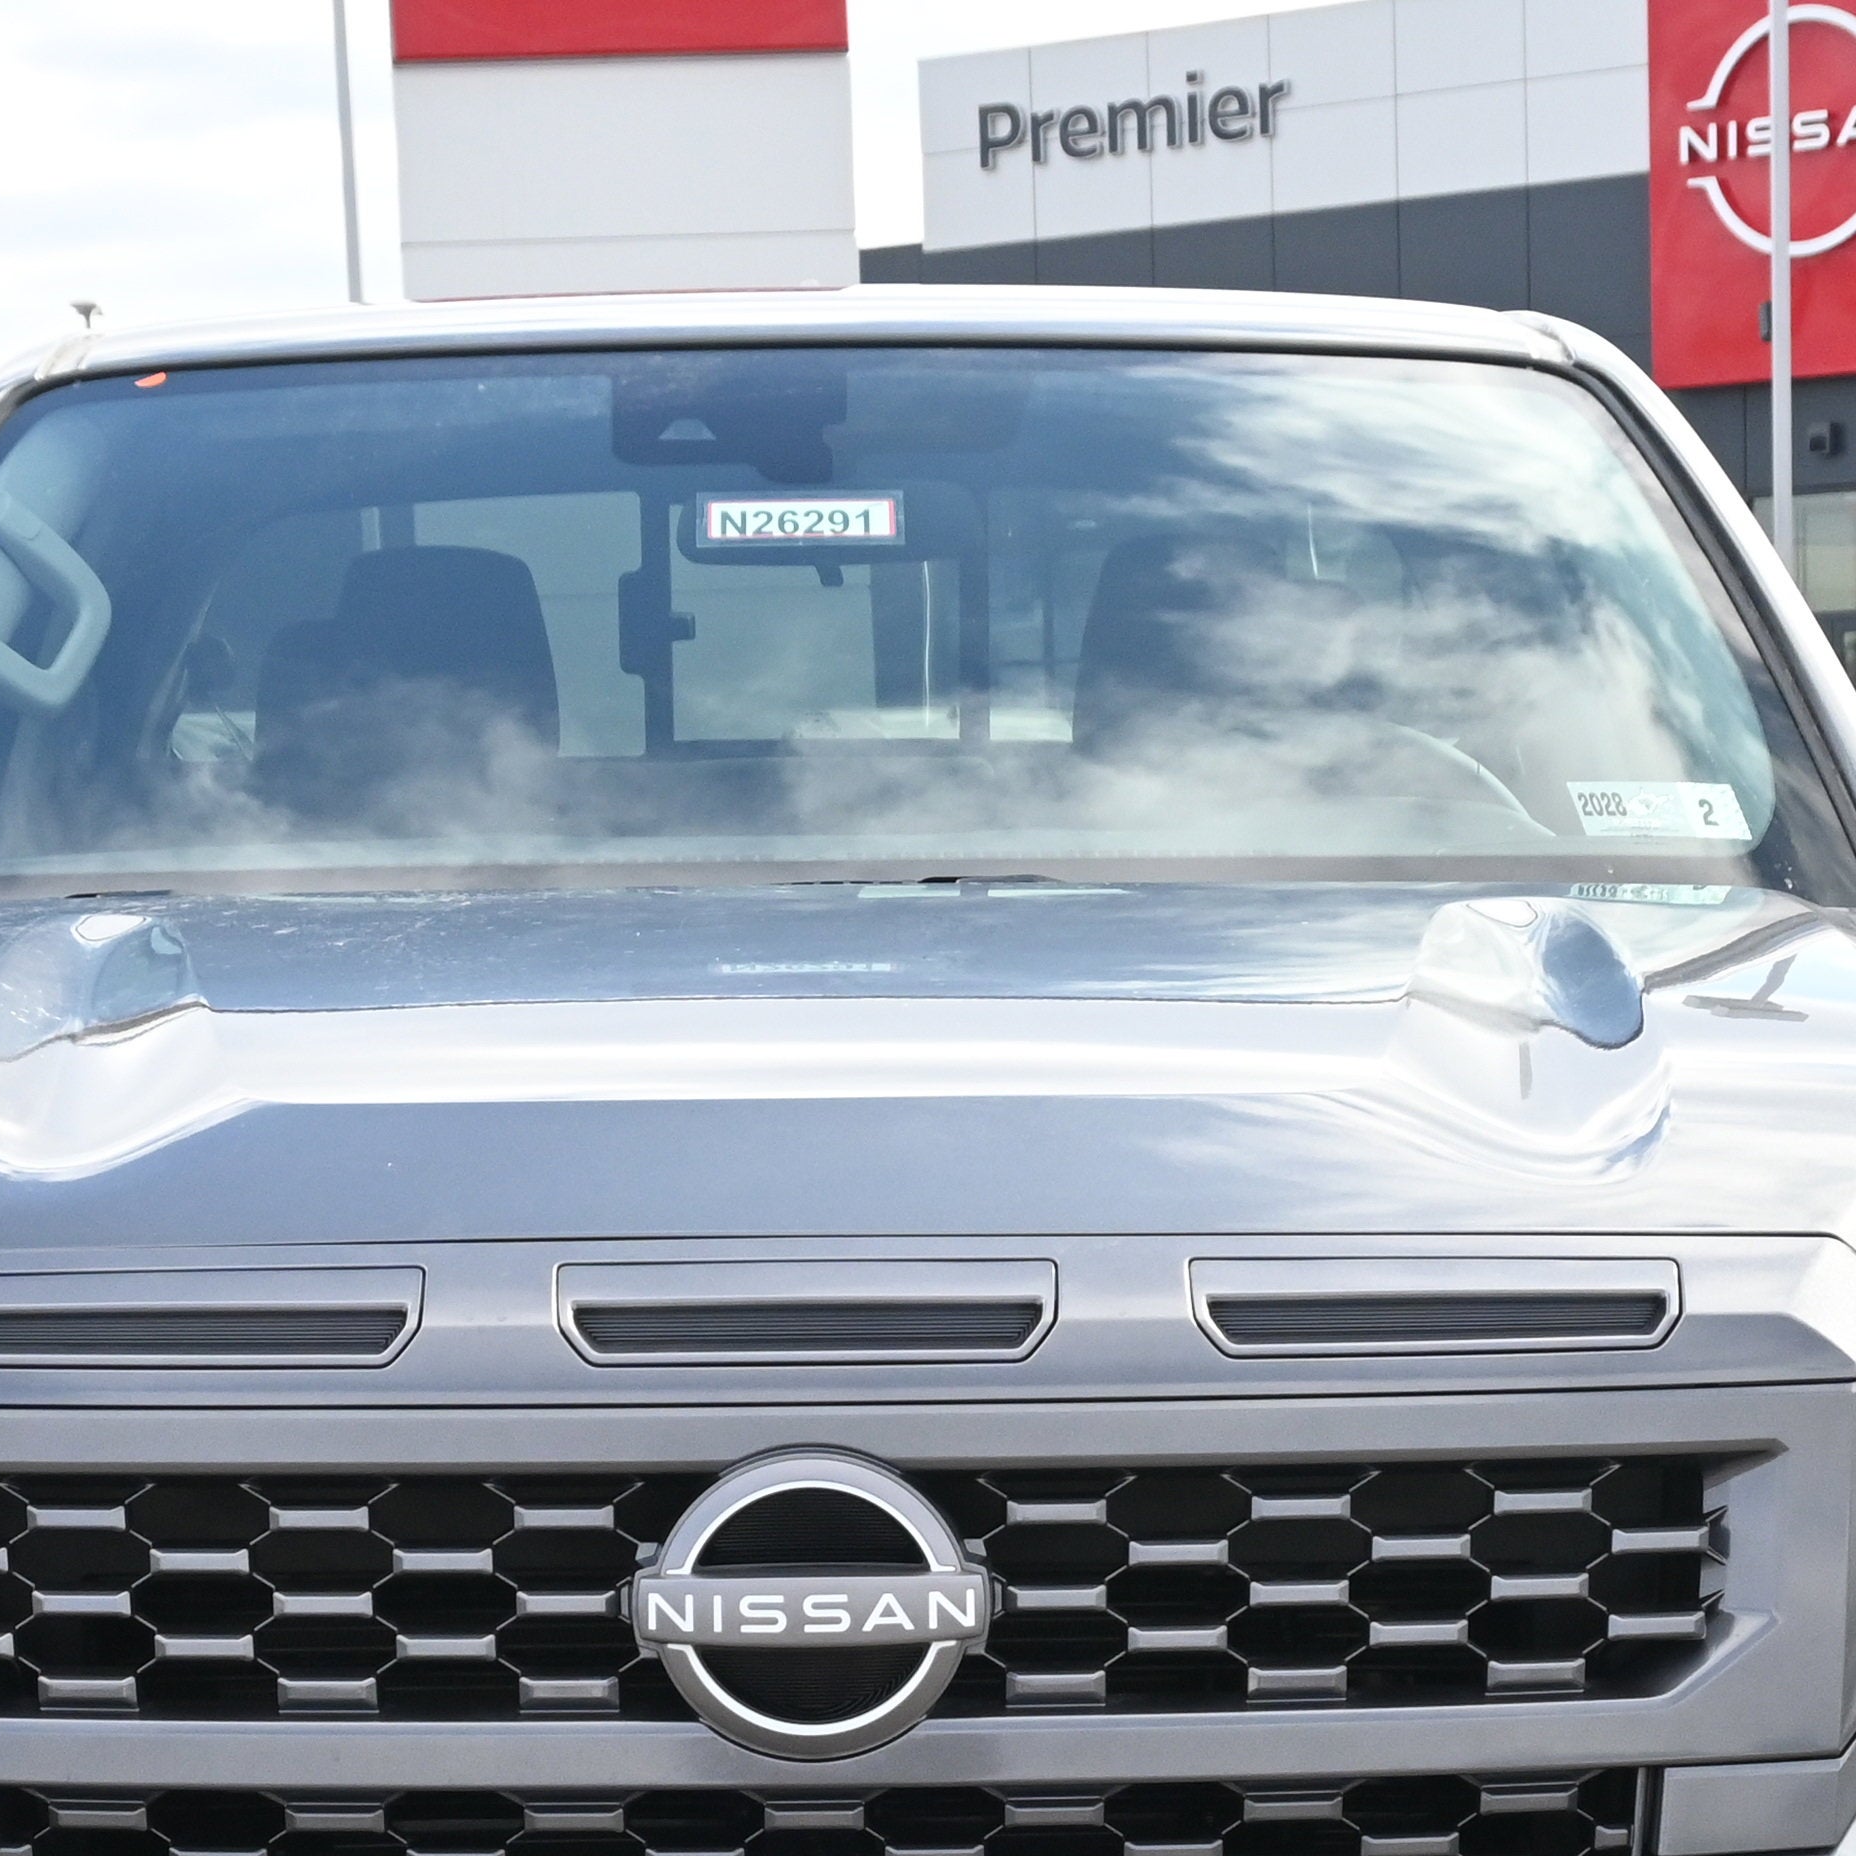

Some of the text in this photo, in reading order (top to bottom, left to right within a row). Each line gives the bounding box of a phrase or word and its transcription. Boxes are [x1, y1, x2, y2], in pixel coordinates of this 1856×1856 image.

[978, 70, 1289, 169] Premier
[720, 508, 871, 536] N26291
[1577, 791, 1720, 826] 2028 2
[647, 1588, 976, 1633] NISSAN
